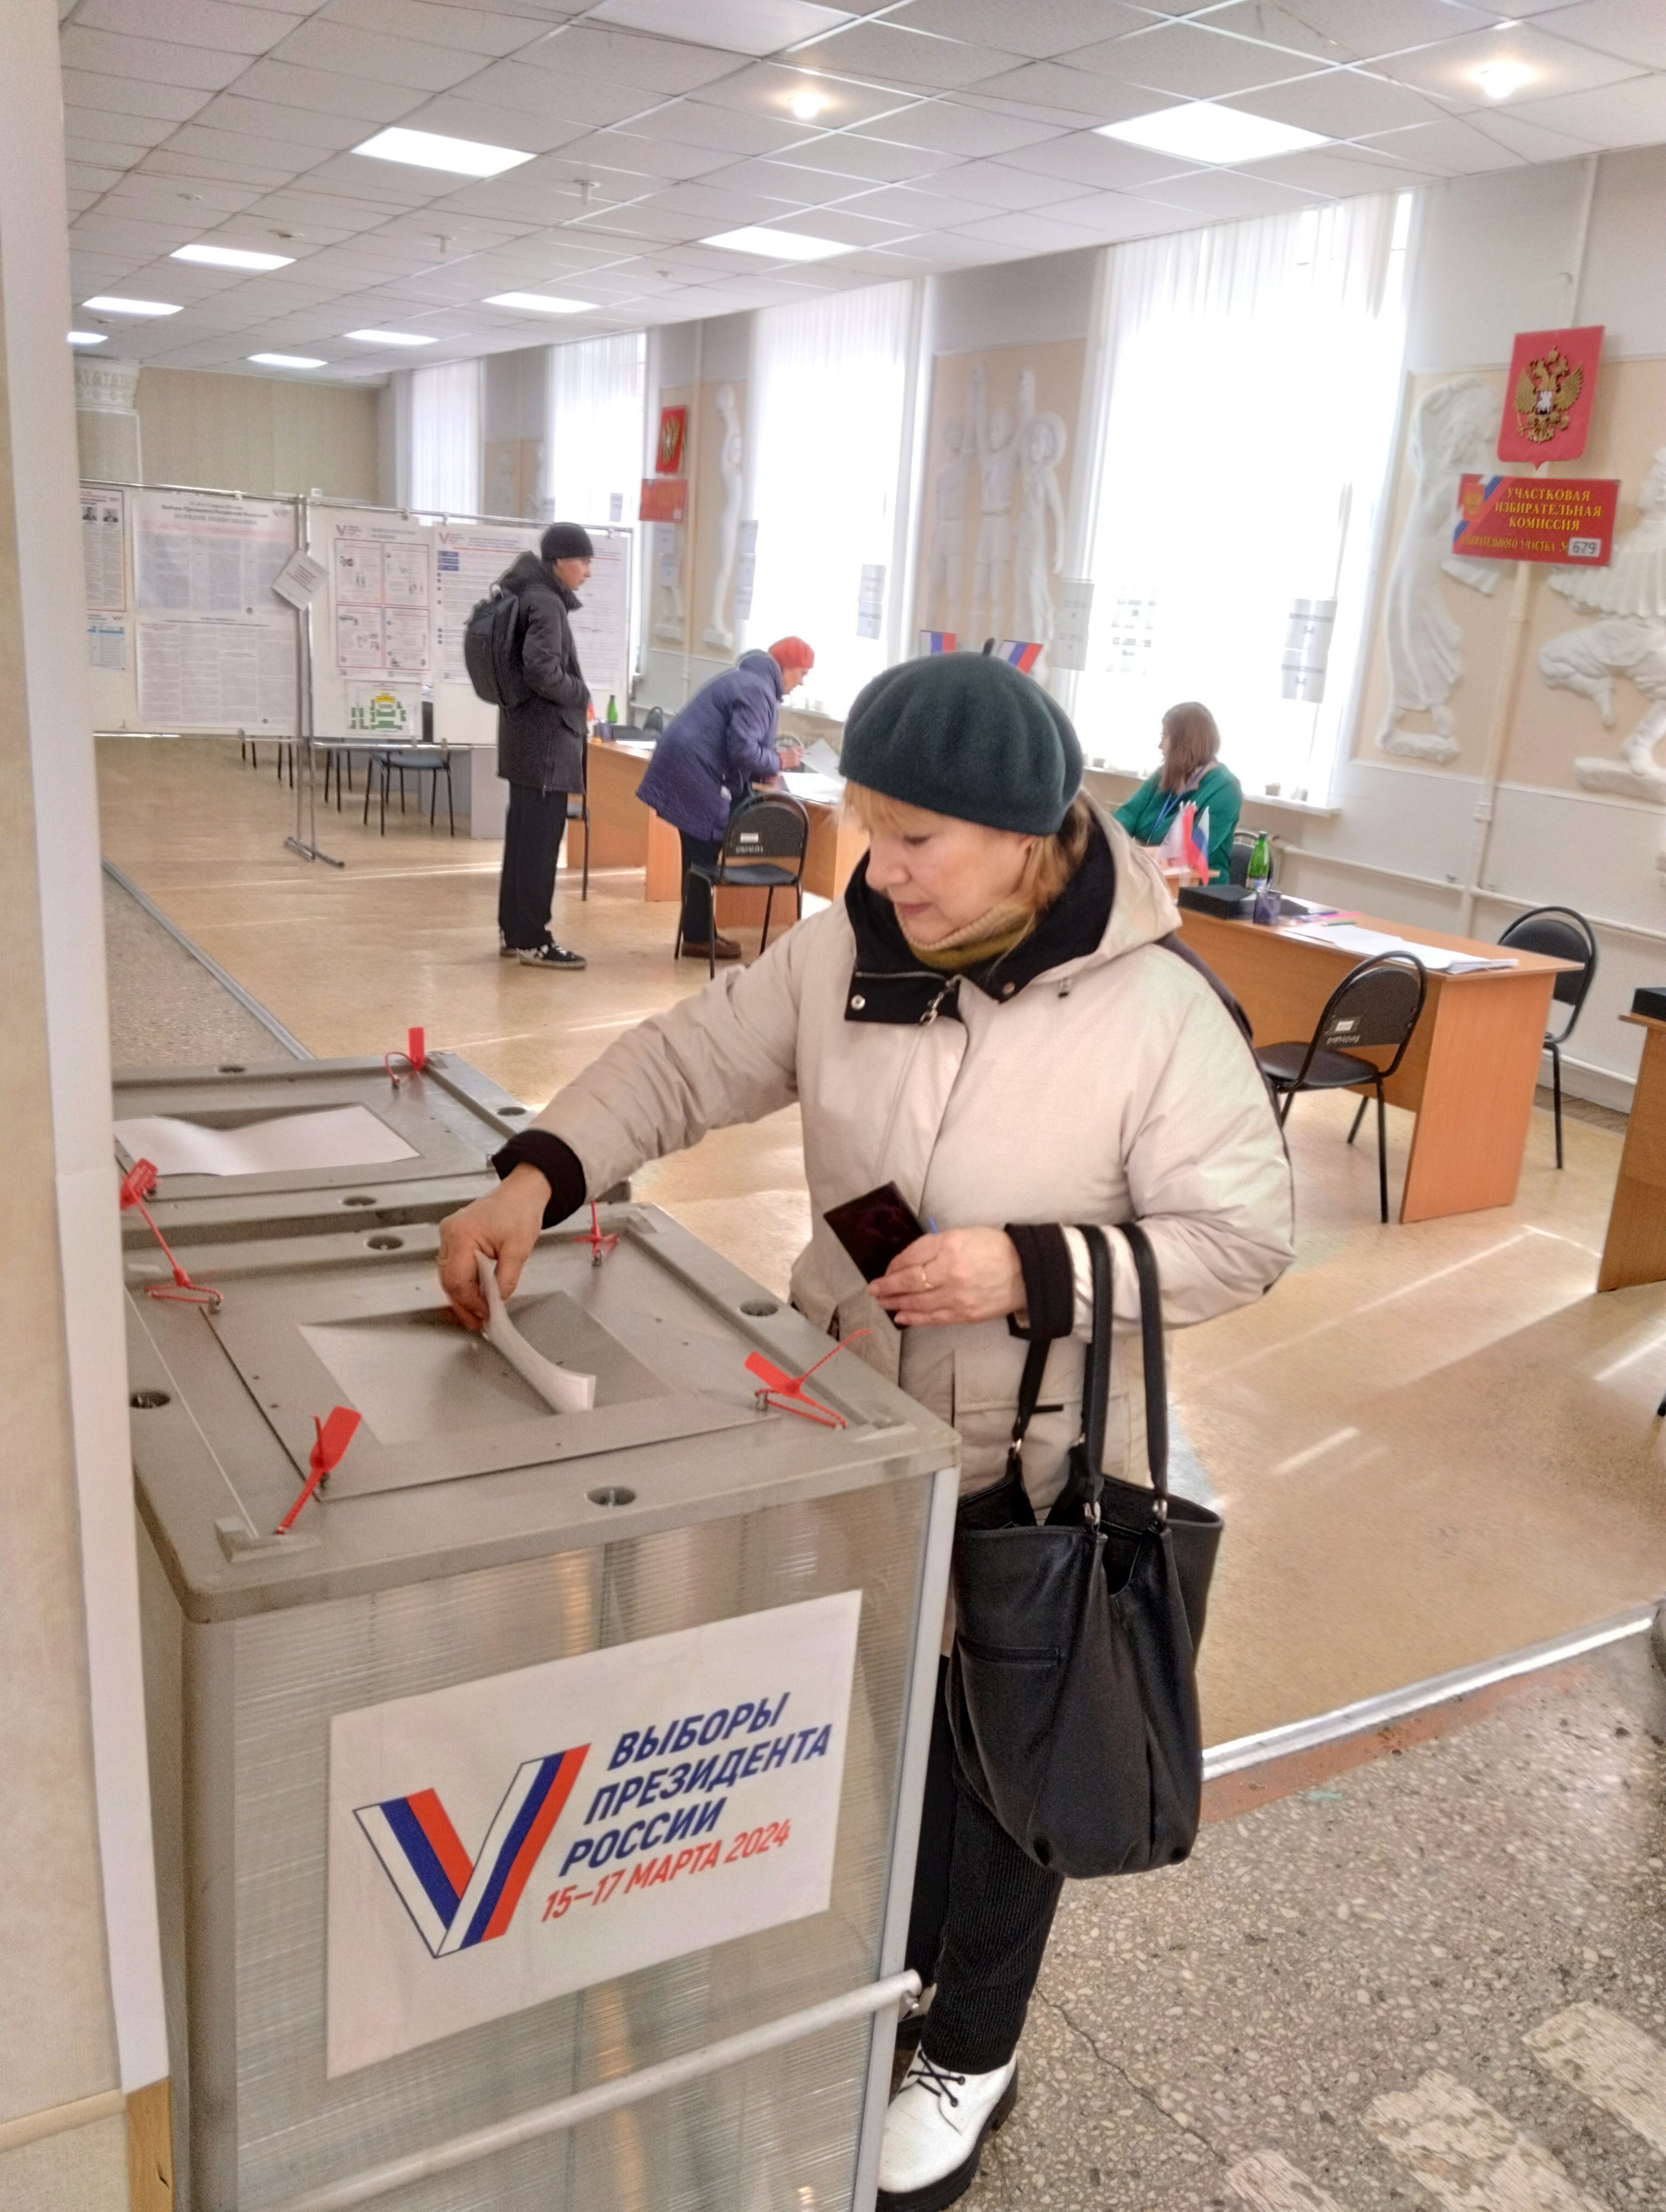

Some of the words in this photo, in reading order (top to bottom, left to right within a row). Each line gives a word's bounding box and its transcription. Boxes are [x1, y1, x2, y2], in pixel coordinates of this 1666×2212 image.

[1495, 501, 1603, 517] ИЗБИРАТЕЛЬНАЯ
[1507, 487, 1591, 502] УЧАСТКОВАЯ
[1509, 517, 1579, 531] КОМИССИЯ
[1520, 538, 1555, 552] УЧАСТКА
[1573, 541, 1597, 555] 679
[607, 1692, 791, 1771] ВЫБОРЫ
[583, 1724, 833, 1825] ПРЕЗИДЕНТА
[558, 1797, 727, 1877] РОССИИ
[623, 1839, 722, 1895] МАРТА
[722, 1819, 791, 1864] 2024
